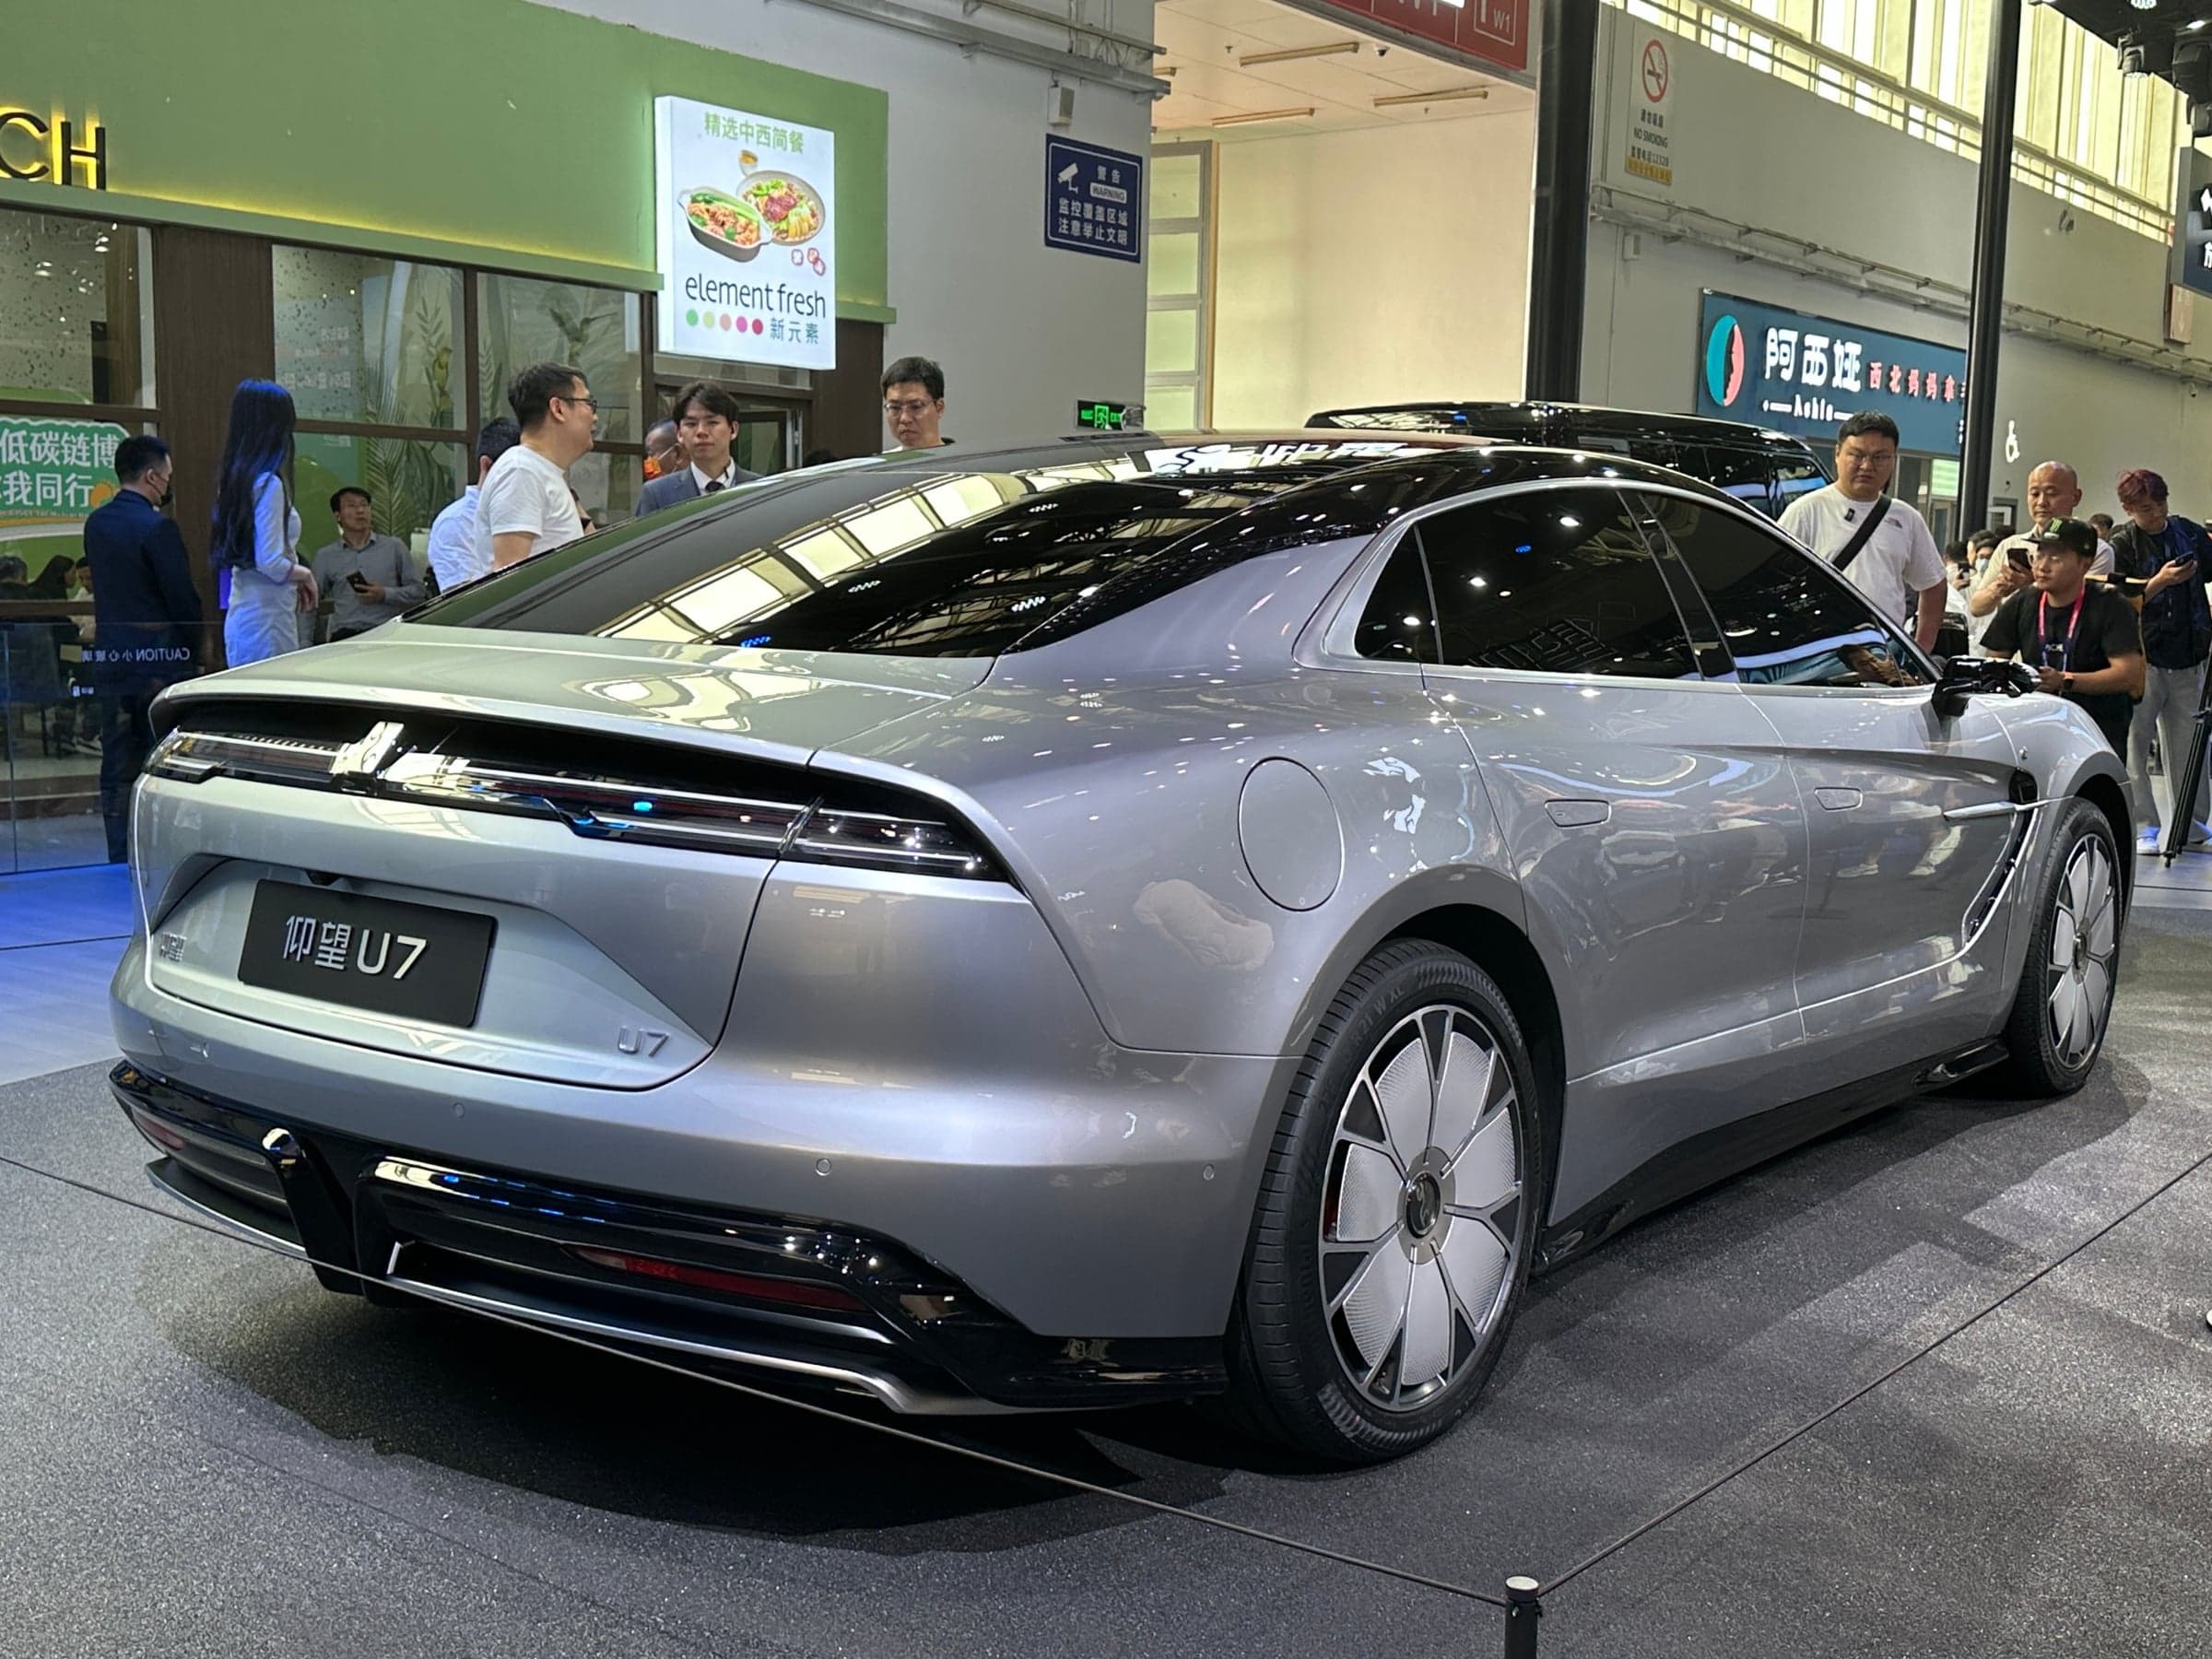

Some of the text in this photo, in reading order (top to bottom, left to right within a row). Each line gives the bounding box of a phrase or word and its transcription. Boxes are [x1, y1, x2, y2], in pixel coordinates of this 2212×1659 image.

[1494, 8, 1510, 33] W1
[704, 112, 805, 154] 精选中西简餐
[1633, 125, 1668, 148] NO SMOKING
[0, 111, 106, 191] CH
[1058, 196, 1128, 227] 监控覆盖区域
[1058, 217, 1128, 246] 注意举止文明
[685, 272, 827, 319] element fresh
[769, 317, 819, 345] 新元素
[1764, 327, 1966, 403] 阿西娅 西北妈妈拿
[0, 470, 95, 508] 我同行
[617, 1026, 671, 1058] U7
